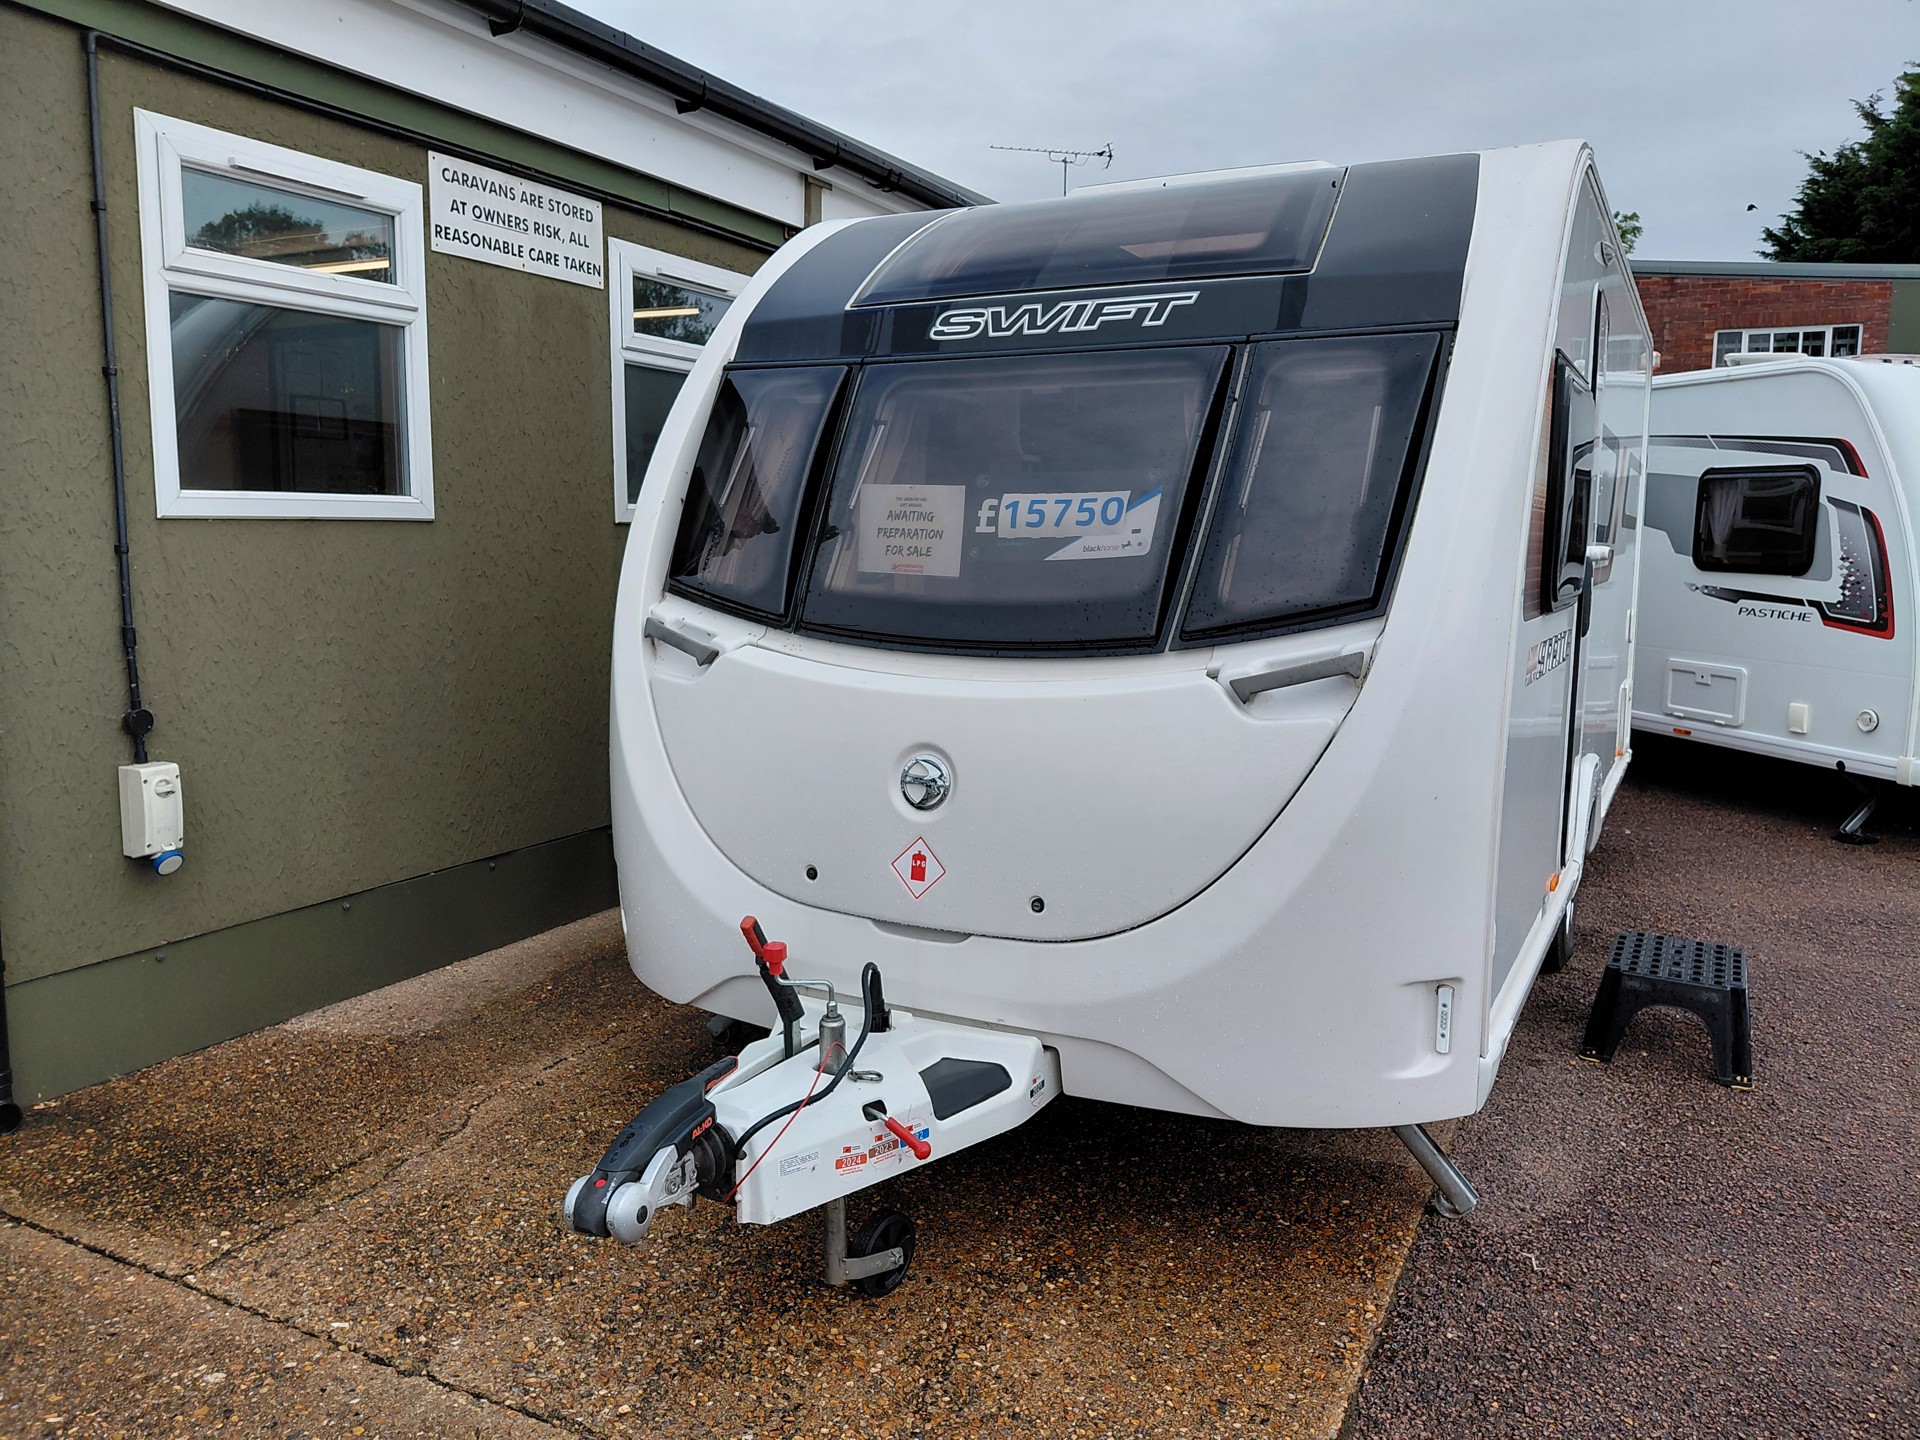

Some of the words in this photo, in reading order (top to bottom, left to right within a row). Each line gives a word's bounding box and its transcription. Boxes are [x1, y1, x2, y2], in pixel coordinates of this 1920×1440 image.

[441, 167, 516, 201] CARAVANS
[519, 190, 544, 209] ARE
[548, 198, 594, 223] STORED
[450, 198, 467, 215] AT
[472, 204, 529, 233] OWNERS
[533, 221, 565, 244] RISK,
[569, 231, 589, 248] ALL
[434, 223, 524, 259] REASONABLE
[528, 247, 560, 267] CARE
[564, 255, 601, 277] TAKEN
[929, 290, 1201, 341] SWIFT
[887, 509, 935, 522] AWAITING
[975, 496, 1125, 533] £15750
[877, 527, 944, 540] PREPARATION
[885, 544, 904, 557] FOR
[906, 545, 932, 558] SALE
[1082, 542, 1120, 553] blackhorse
[1738, 606, 1813, 623] PASTICHE
[912, 859, 926, 868] LPG
[874, 1141, 894, 1156] 2023
[841, 1155, 862, 1168] 2024
